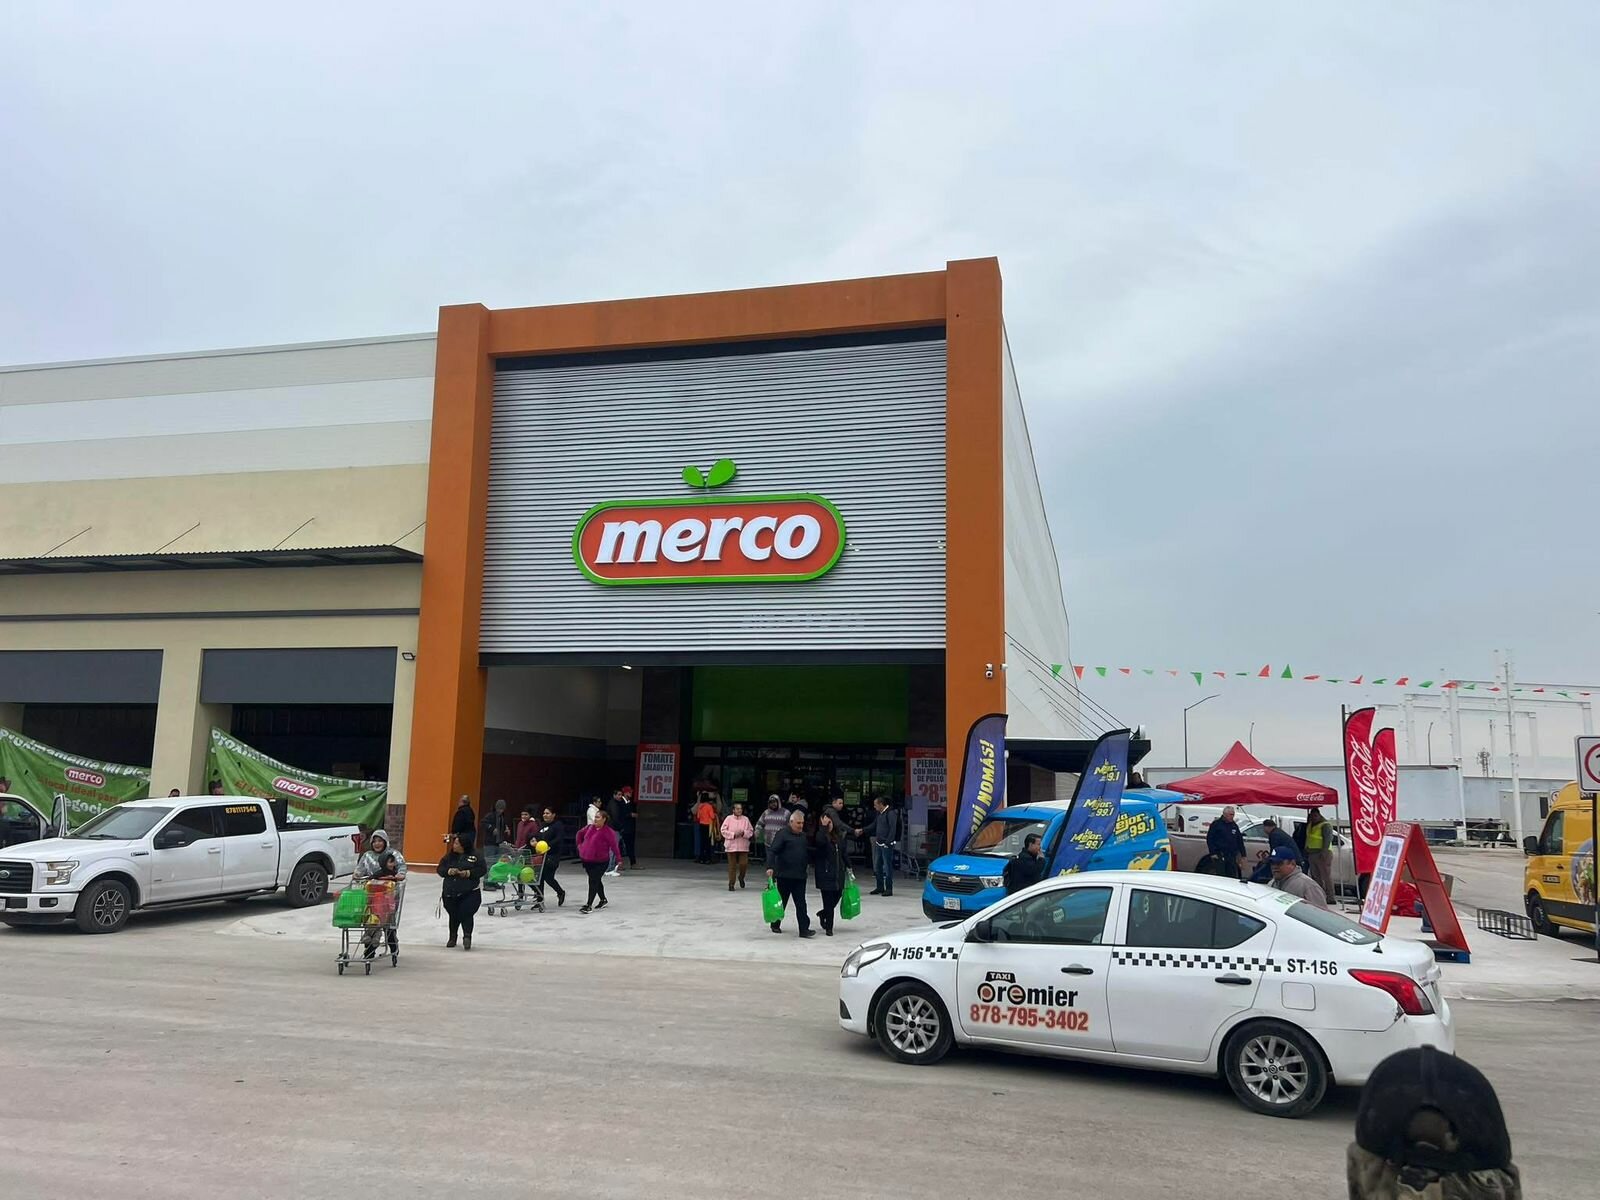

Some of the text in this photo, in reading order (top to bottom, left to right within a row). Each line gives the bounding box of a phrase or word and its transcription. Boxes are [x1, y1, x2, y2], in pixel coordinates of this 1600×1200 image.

[594, 513, 821, 565] merco
[643, 753, 673, 763] TOMATE
[916, 759, 944, 768] PIERNA
[68, 769, 103, 785] merco
[275, 779, 316, 797] merco
[1130, 818, 1155, 837] 99.1
[889, 947, 923, 960] N-156
[1287, 958, 1338, 976] ST-156
[989, 972, 1011, 981] TAXI
[970, 1003, 1089, 1032] 878-795-3402
